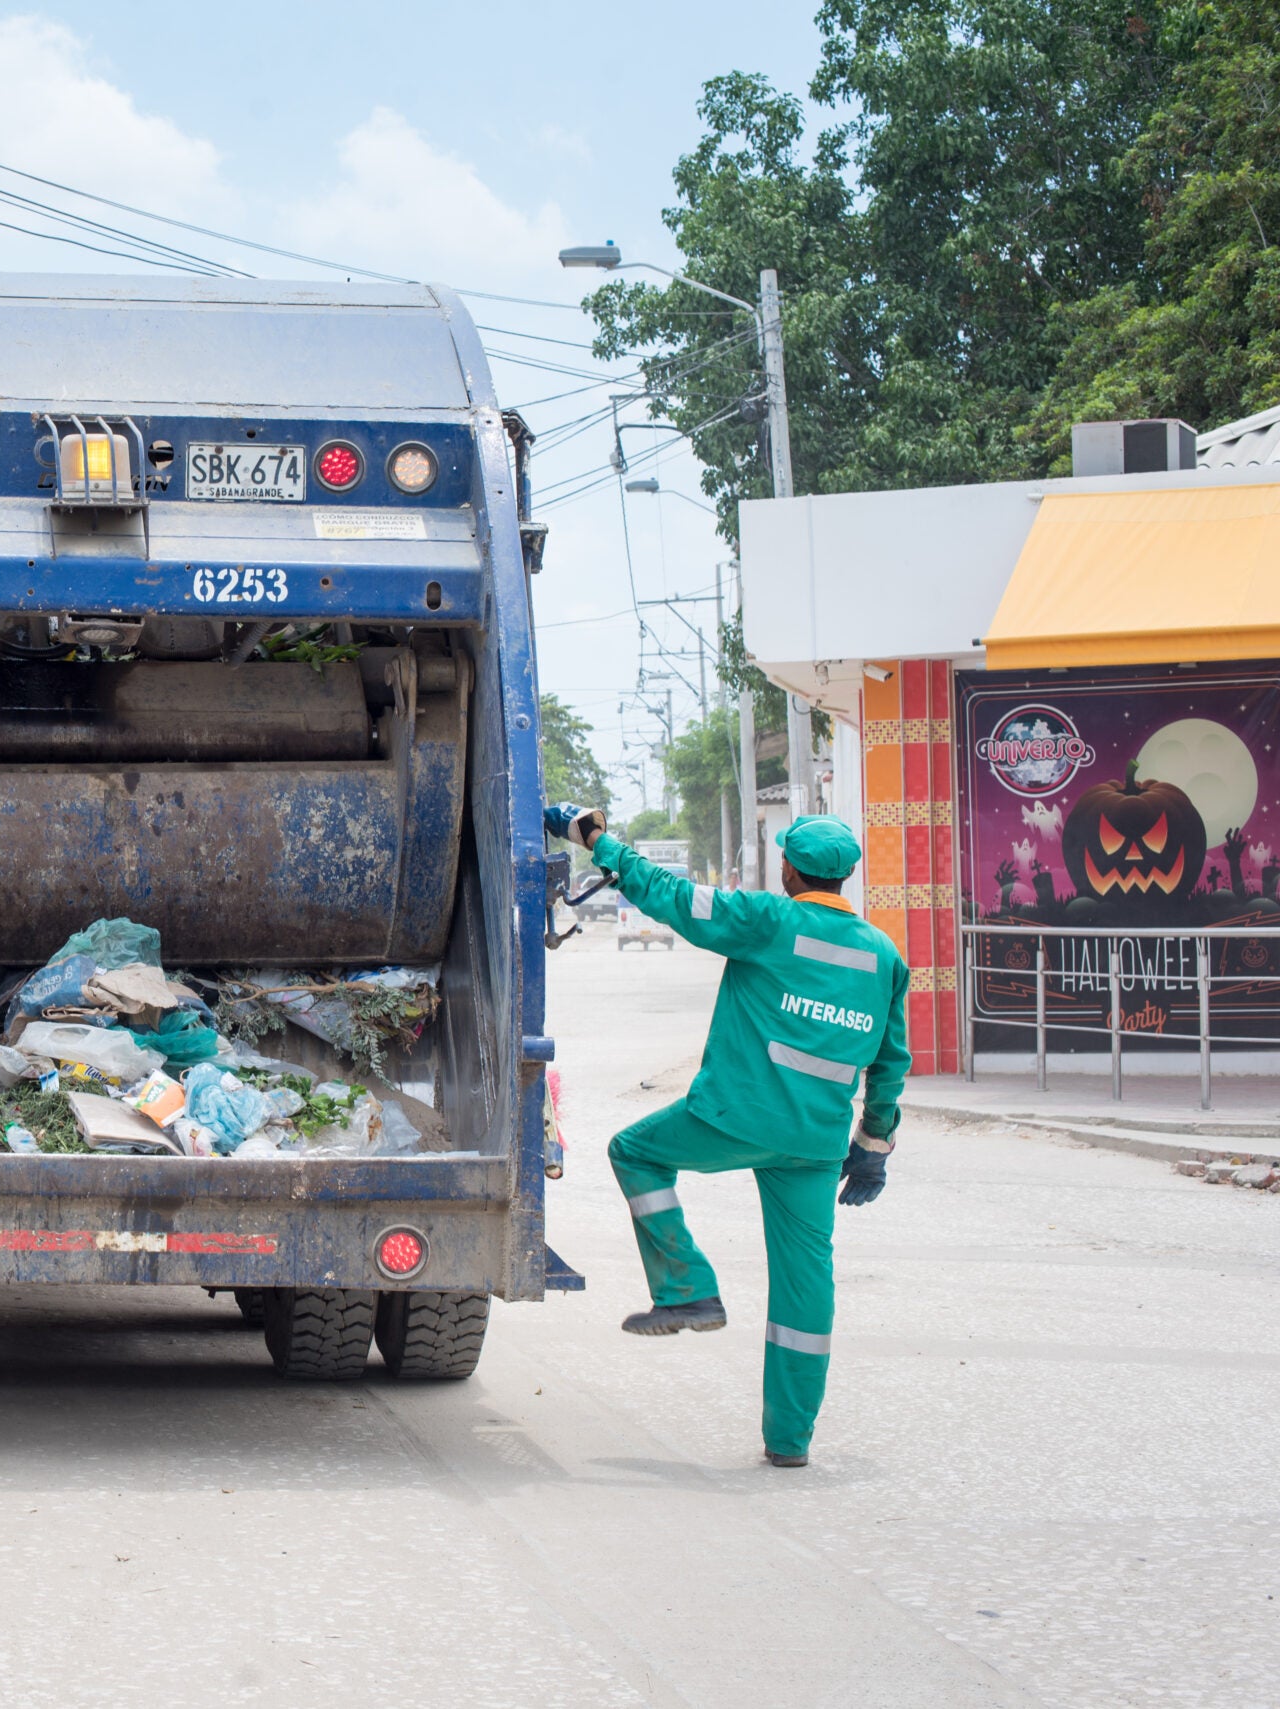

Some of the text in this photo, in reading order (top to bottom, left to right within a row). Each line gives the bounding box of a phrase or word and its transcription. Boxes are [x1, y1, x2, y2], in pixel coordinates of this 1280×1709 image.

[191, 454, 241, 485] SBK
[251, 455, 301, 486] 674
[209, 487, 284, 498] SABANAGRANDE
[193, 568, 289, 602] 6253
[987, 737, 1086, 766] UNIVERSO
[780, 992, 873, 1033] INTERASEO
